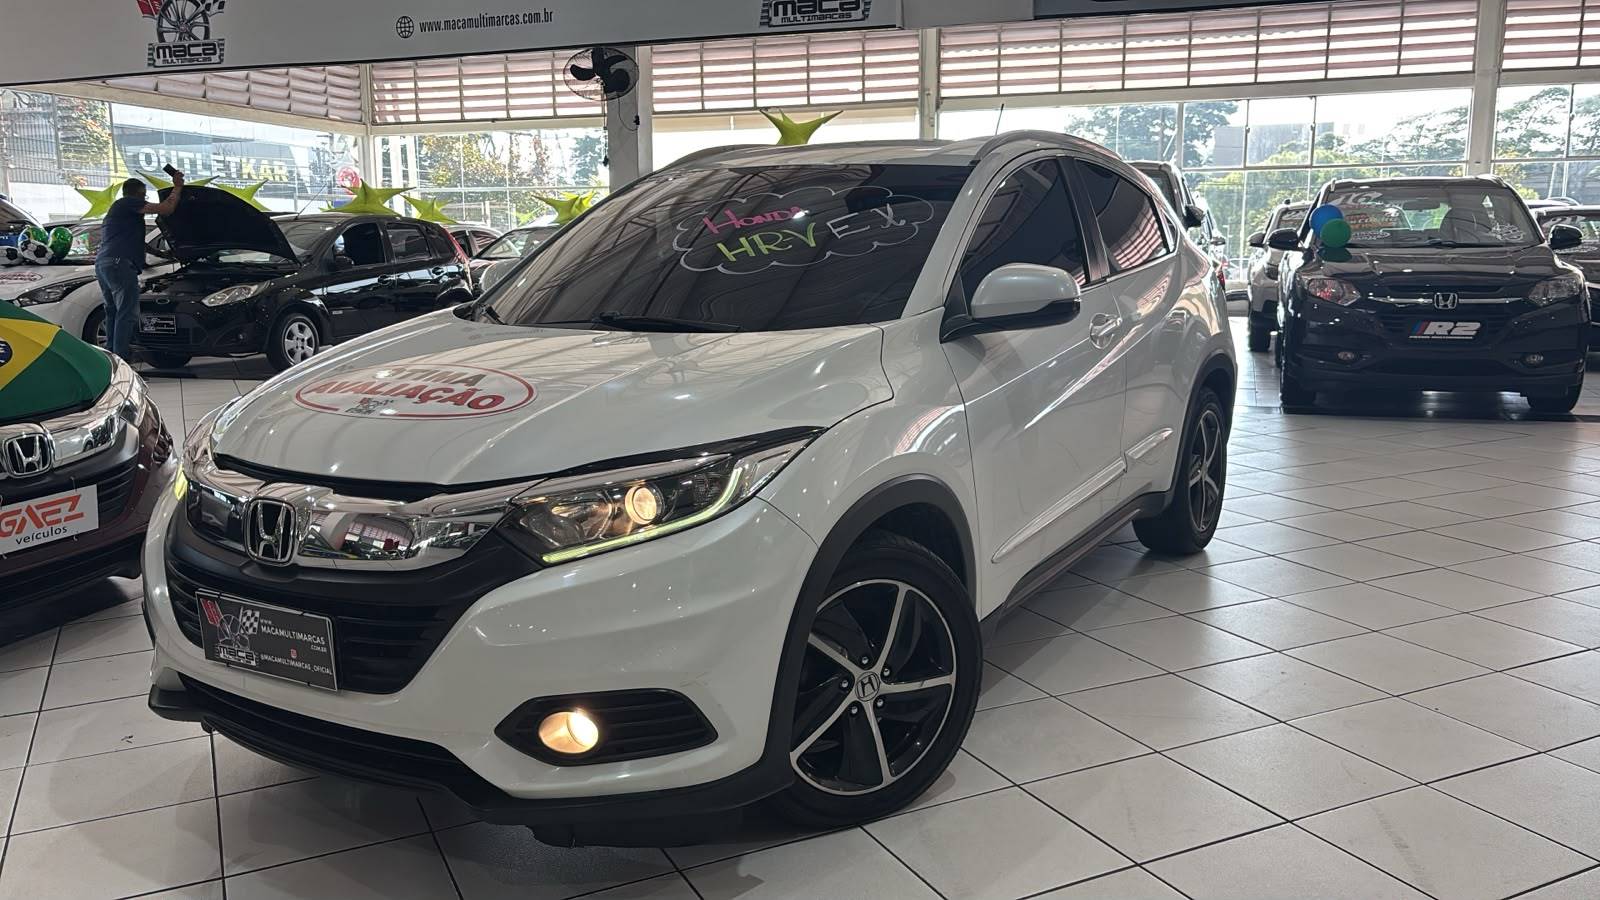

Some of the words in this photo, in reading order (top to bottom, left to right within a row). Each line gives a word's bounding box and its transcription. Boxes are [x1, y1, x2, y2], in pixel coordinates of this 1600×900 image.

[419, 8, 554, 33] www.macamultimarcas.com.br
[1423, 321, 1481, 335] R2
[303, 381, 505, 410] AVALIAÇÃO
[15, 525, 68, 545] veículos
[261, 625, 326, 645] MACAMULTIMARCAS
